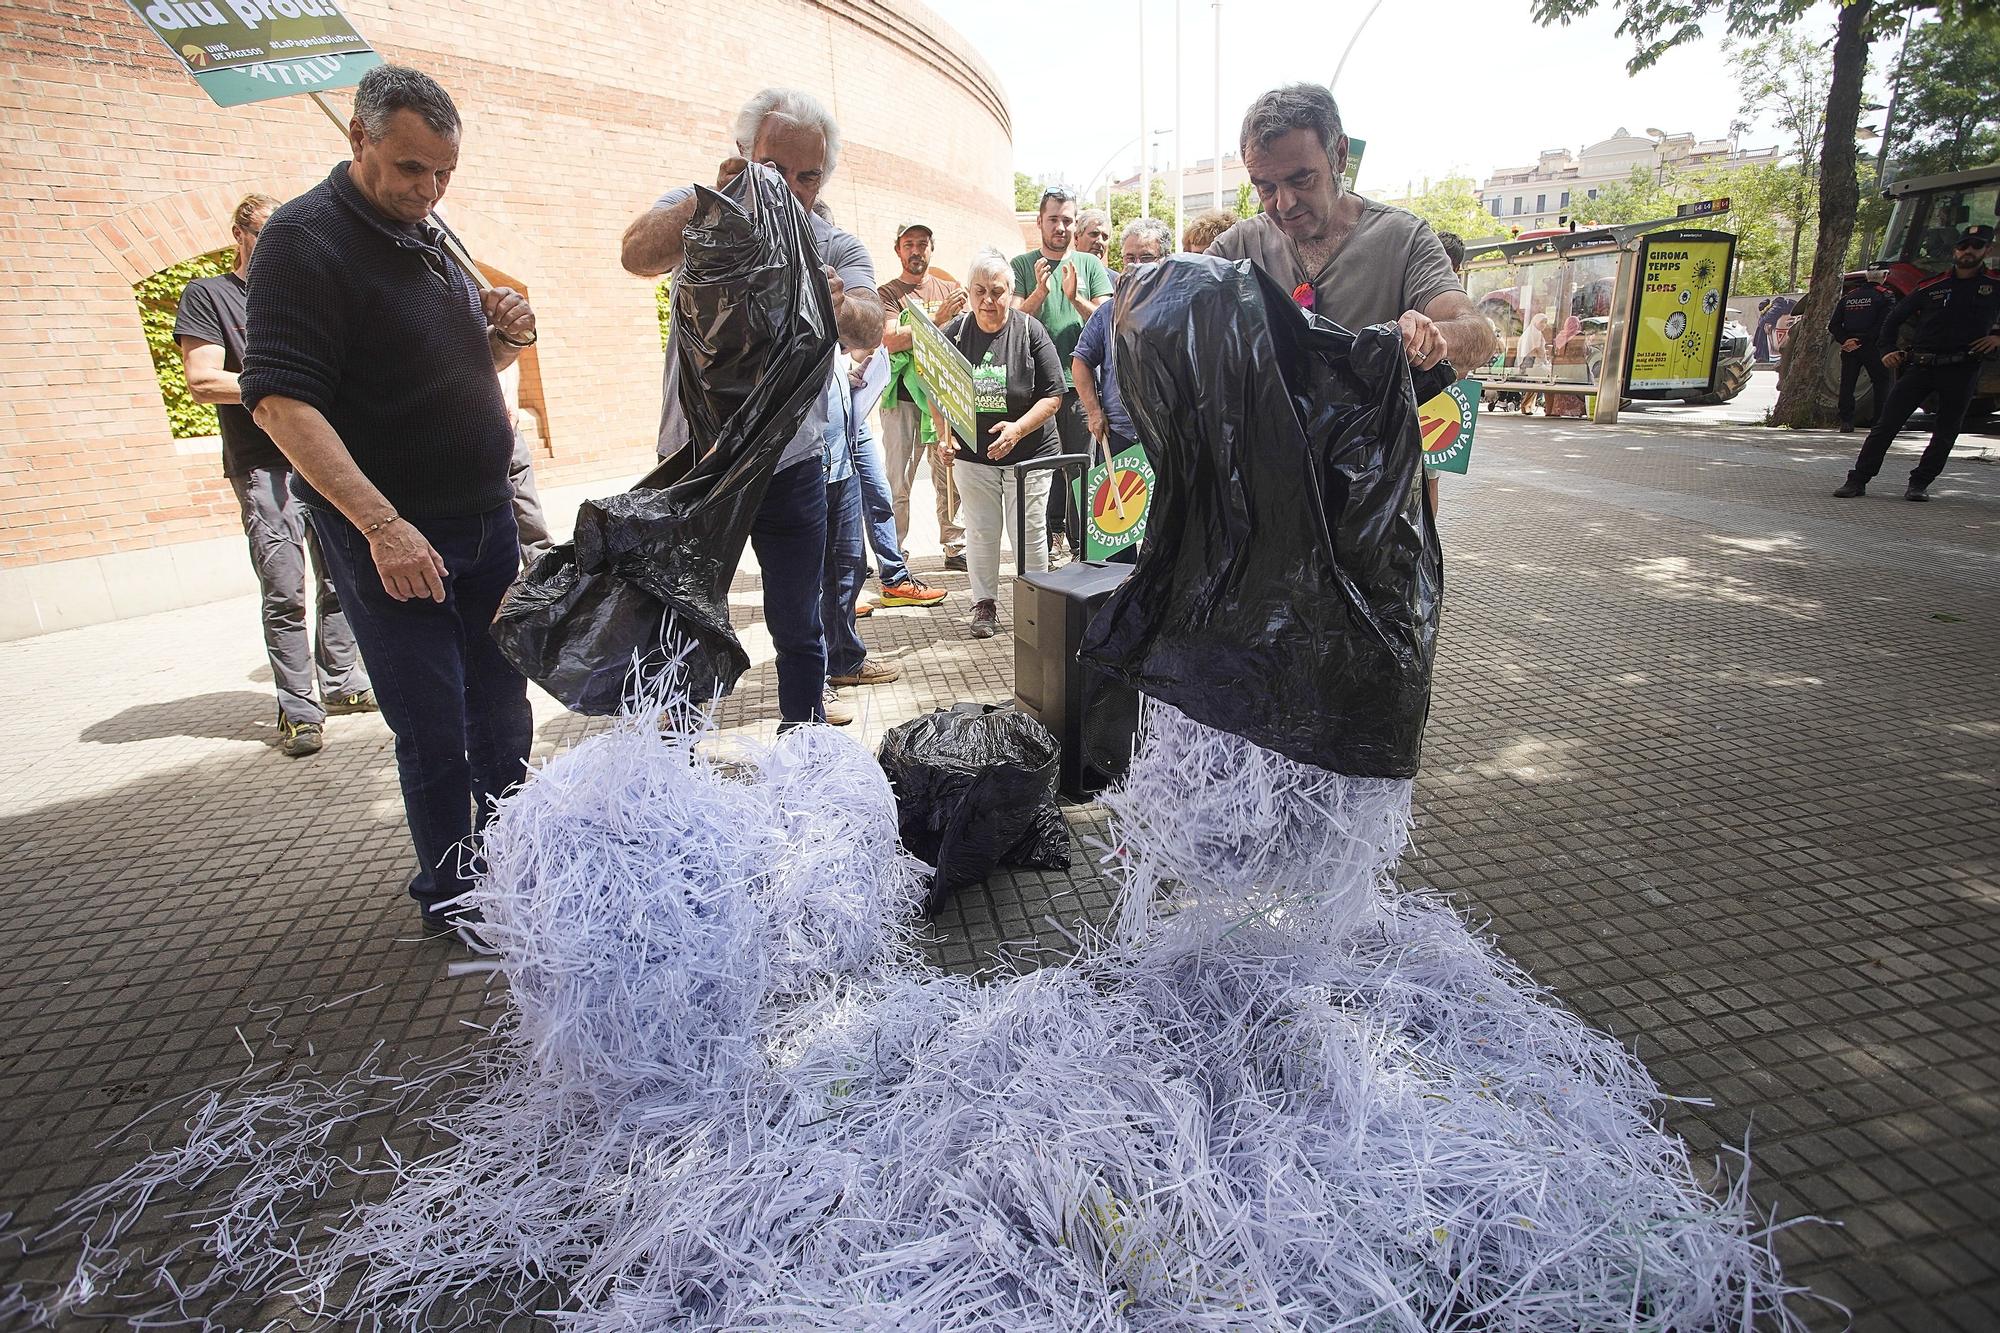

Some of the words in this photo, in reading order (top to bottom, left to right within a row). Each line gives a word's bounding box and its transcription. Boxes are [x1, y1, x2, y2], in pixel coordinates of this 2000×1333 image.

[146, 0, 229, 30] diu
[205, 42, 230, 53] UNIÓ
[269, 34, 359, 49] #LaPagesiaDiuProu
[211, 52, 227, 61] DE
[224, 47, 265, 59] PAGESOS
[231, 53, 345, 85] ATALU
[1650, 251, 1689, 260] GIRONA
[1648, 262, 1680, 271] TEMPS
[1647, 273, 1660, 282] DE
[1645, 283, 1677, 292] FLORS
[912, 331, 926, 352] La
[928, 349, 972, 404] pagesia
[915, 349, 936, 378] diu
[938, 373, 973, 420] prou!
[1446, 385, 1472, 429] AGESOS
[1423, 433, 1471, 465] ALUNYA
[1138, 462, 1154, 479] DE
[1130, 518, 1147, 538] DE
